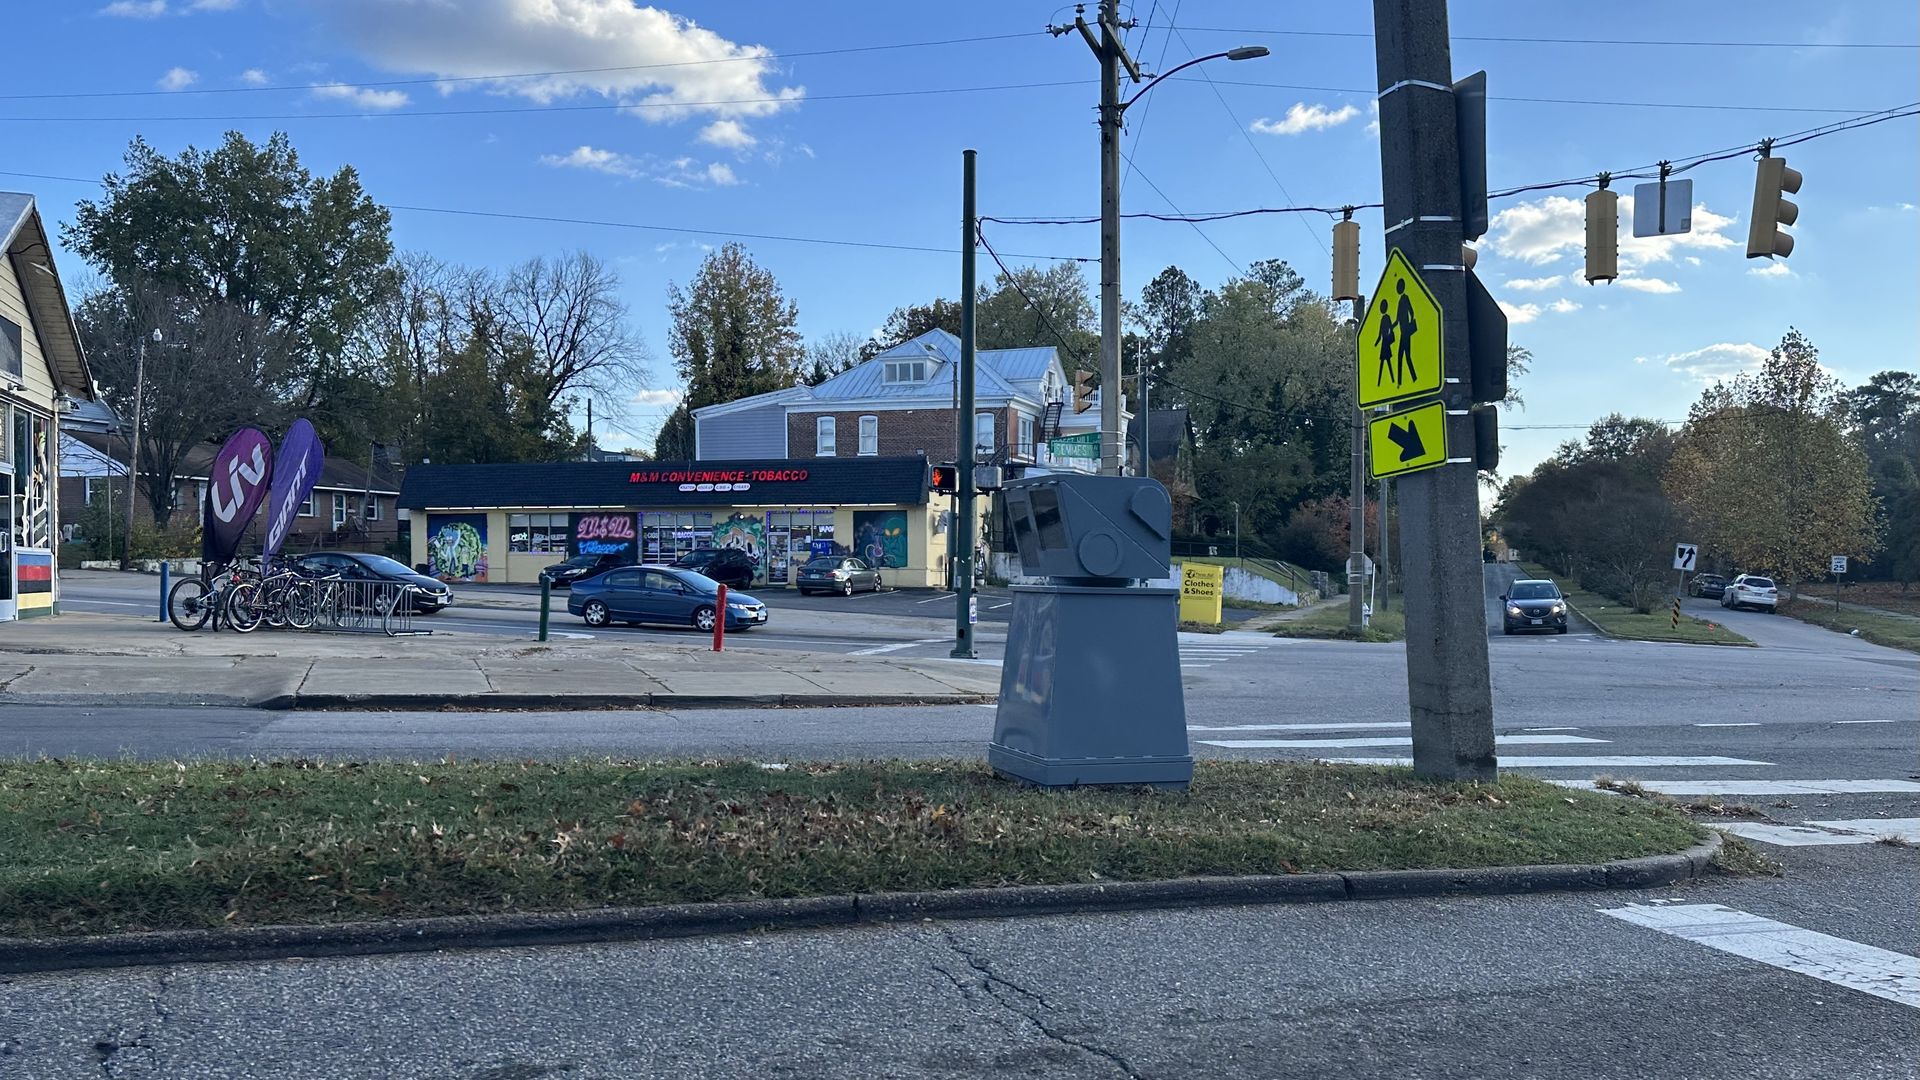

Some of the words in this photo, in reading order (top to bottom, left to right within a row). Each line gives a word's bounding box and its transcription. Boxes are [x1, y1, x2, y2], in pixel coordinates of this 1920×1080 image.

[1054, 444, 1087, 456] SEMMES
[629, 471, 660, 483] M&M
[752, 469, 808, 481] TOBACCO
[268, 447, 308, 551] GIANT
[1184, 579, 1214, 588] Clothes
[1191, 588, 1214, 596] Shoes
